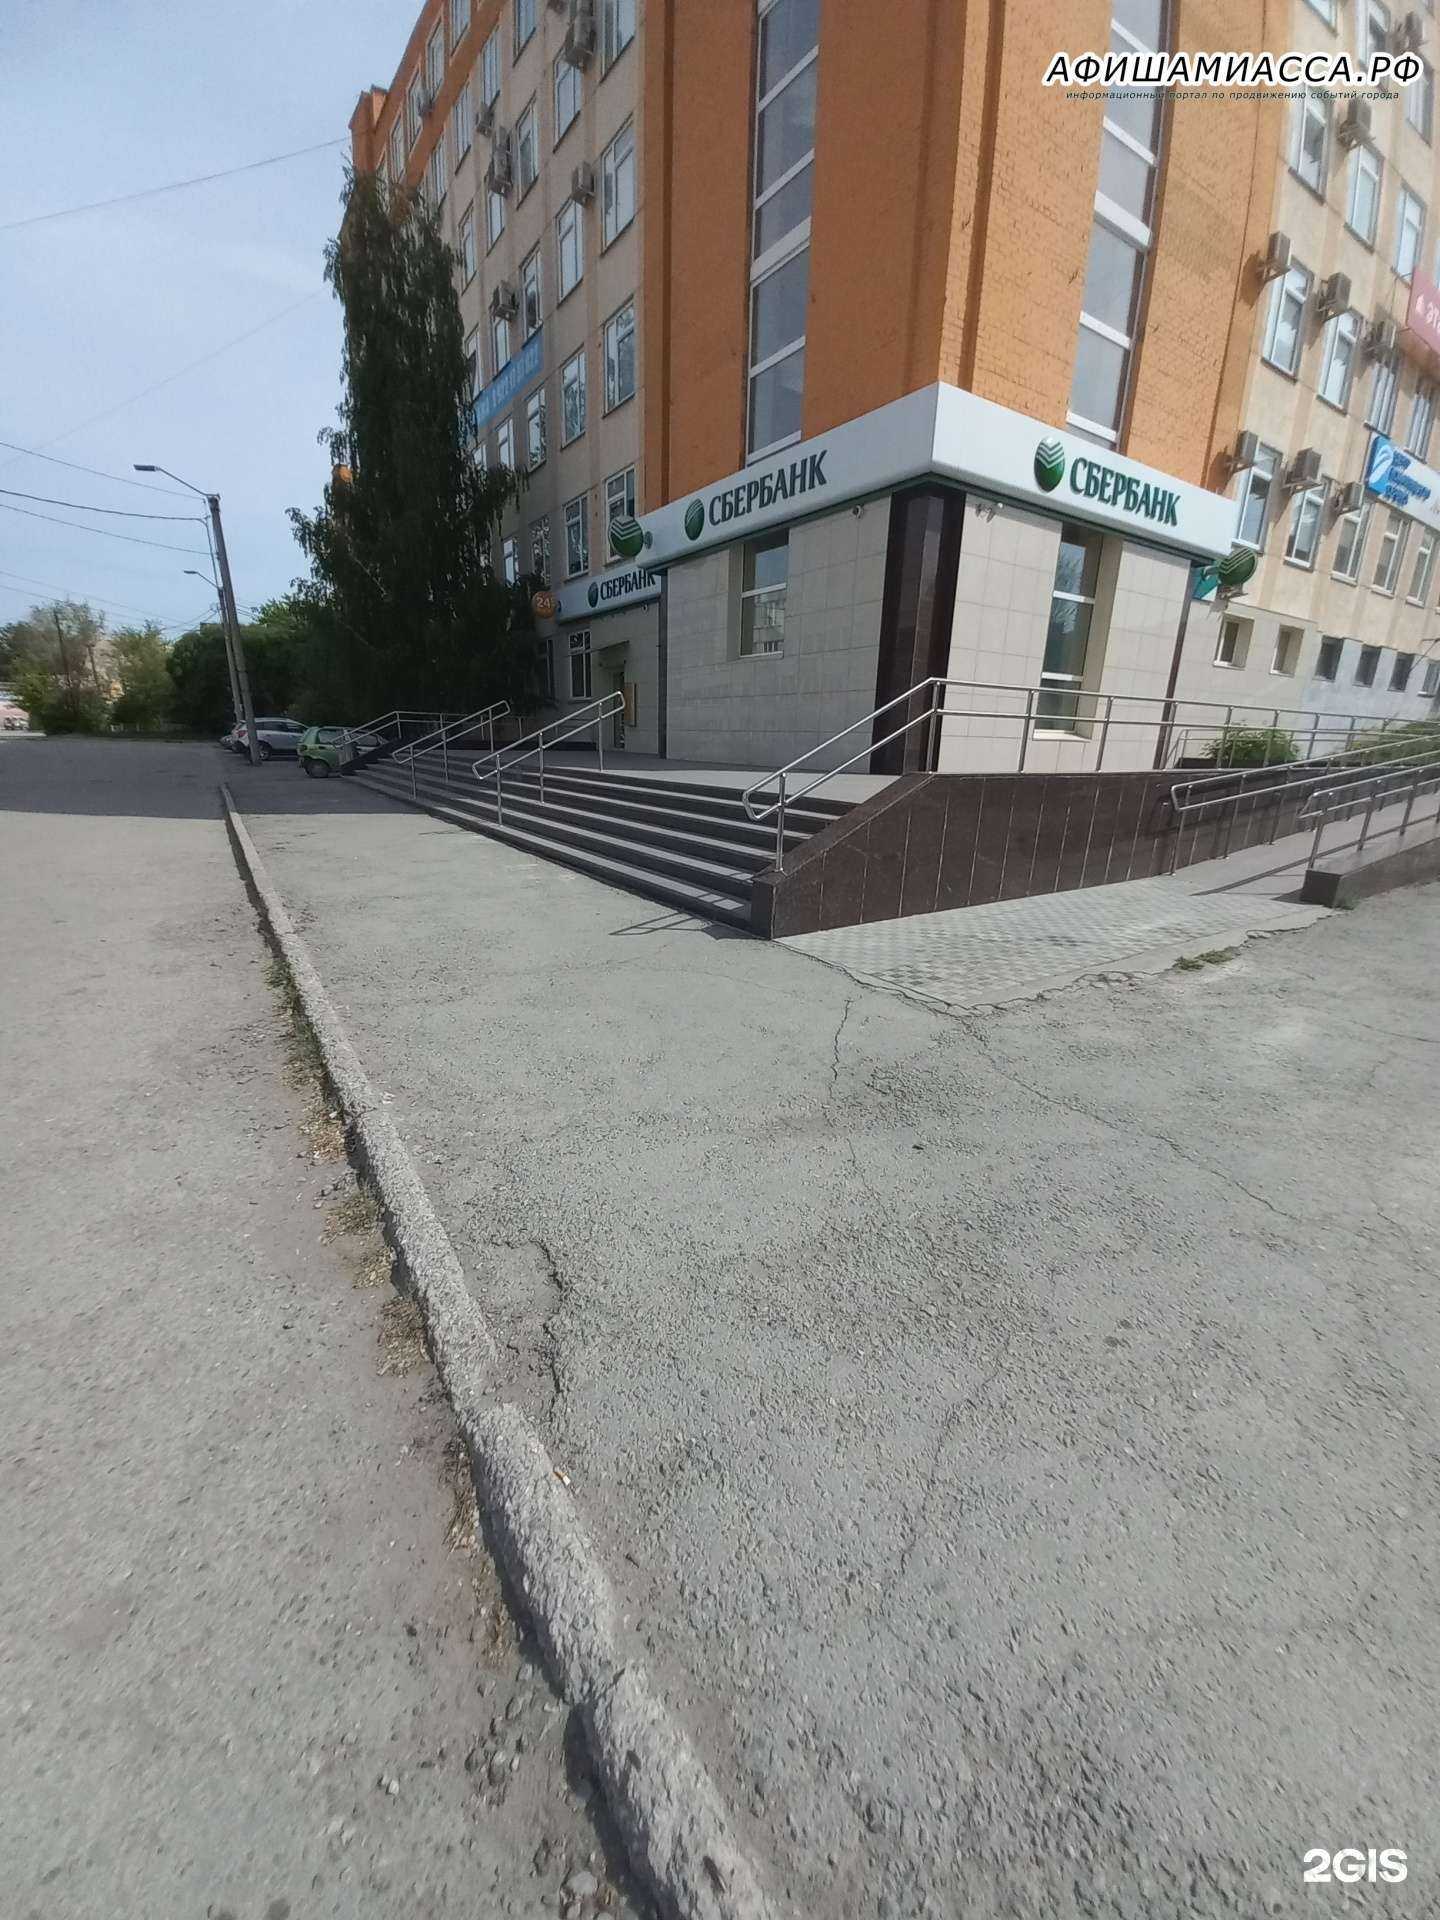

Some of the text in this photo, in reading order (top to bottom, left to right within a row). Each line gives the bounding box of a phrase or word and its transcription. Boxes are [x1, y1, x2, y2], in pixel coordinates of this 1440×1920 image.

[708, 449, 828, 527] СБЕРБАНК
[1069, 457, 1182, 527] СБЕРБАНК
[536, 596, 551, 608] 24
[600, 568, 656, 601] СБЕРБАНК
